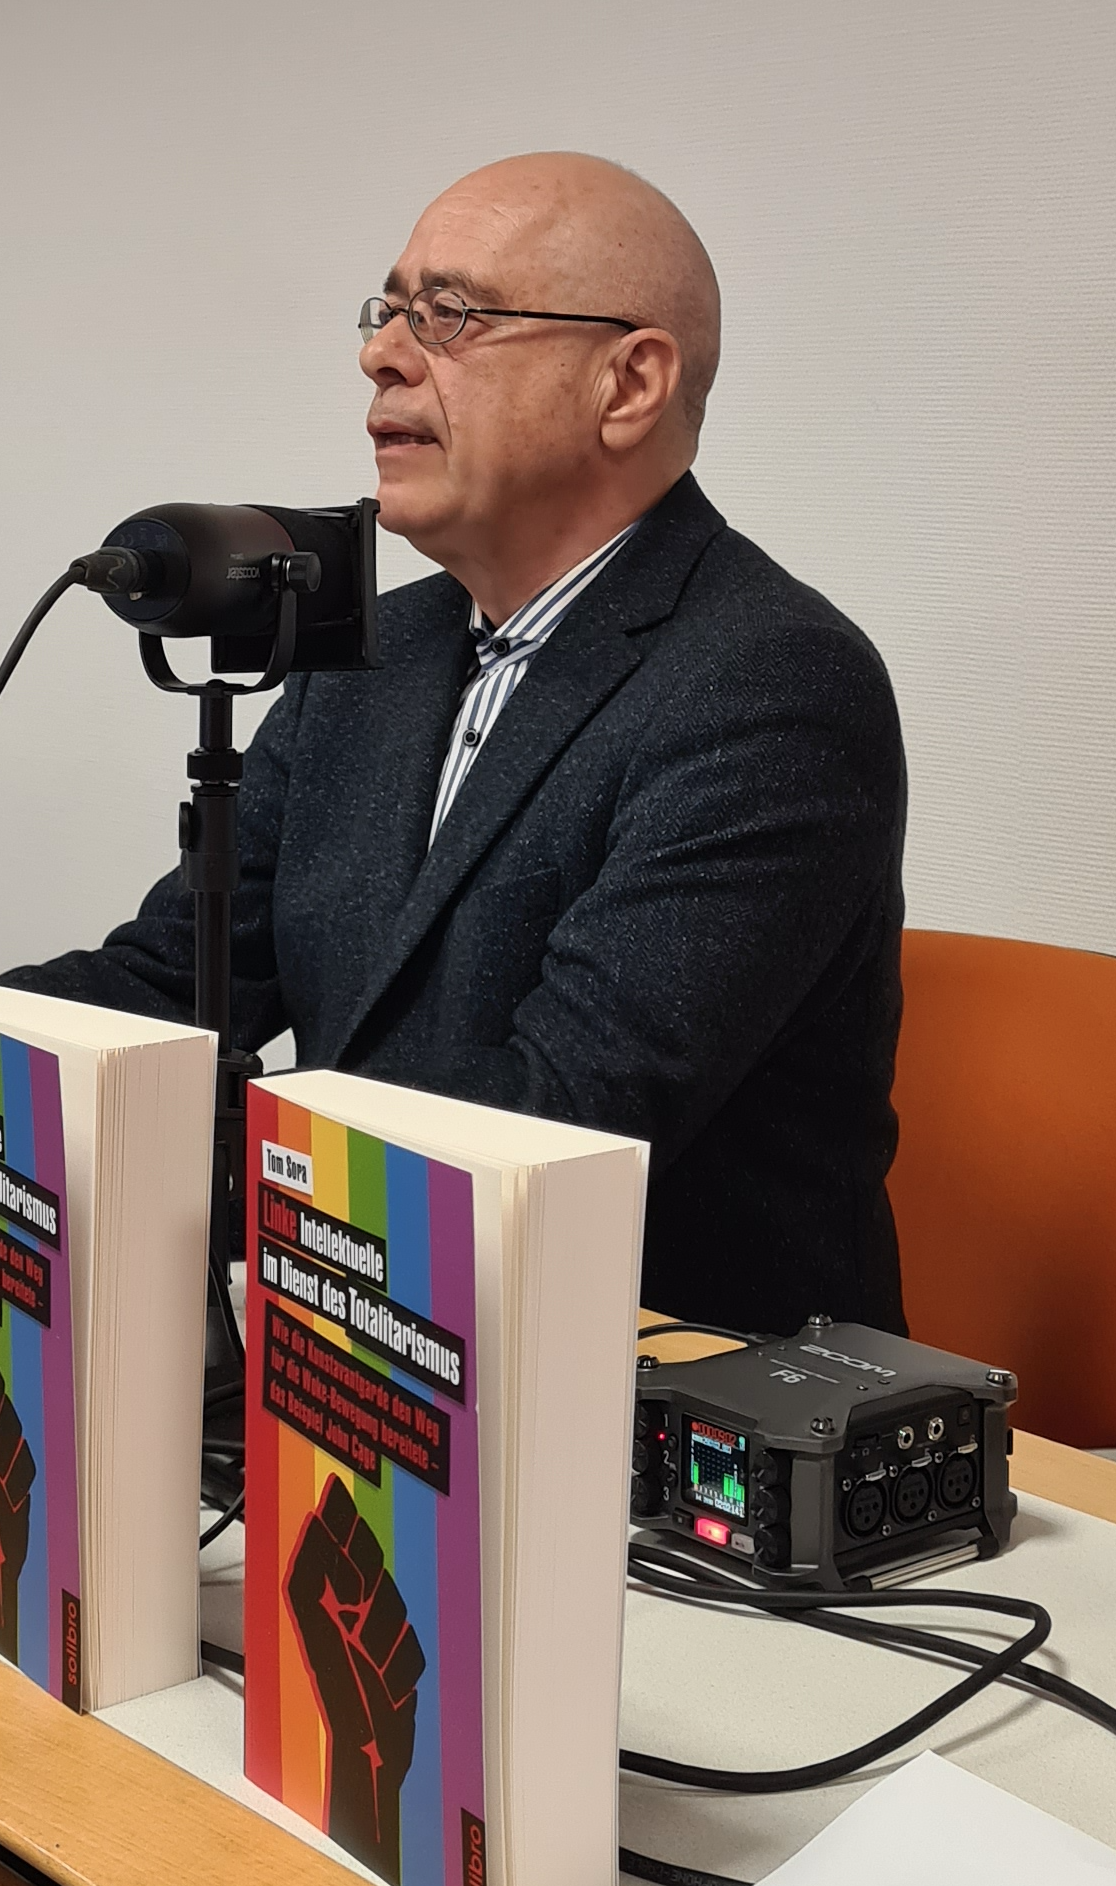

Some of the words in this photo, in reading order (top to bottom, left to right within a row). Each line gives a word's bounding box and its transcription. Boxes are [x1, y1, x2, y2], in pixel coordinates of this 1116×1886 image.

[267, 1148, 284, 1175] Tom
[286, 1155, 307, 1184] Sora
[264, 1190, 297, 1241] Linke
[300, 1211, 384, 1282] Intellektuelle
[10, 1246, 24, 1271] den
[25, 1255, 43, 1287] Weg
[263, 1247, 278, 1285] im
[281, 1255, 320, 1306] Dienst
[322, 1278, 346, 1320] des
[348, 1286, 460, 1386] Totalitarismus
[272, 1314, 289, 1346] Wie
[291, 1329, 305, 1357] die
[307, 1338, 389, 1412] Kunstavantgarde
[392, 1394, 411, 1425] den
[414, 1406, 440, 1447] Weg
[769, 1369, 807, 1384] F6
[799, 1344, 897, 1377] ZOOM
[270, 1346, 284, 1373] für
[286, 1358, 300, 1385] die
[302, 1366, 379, 1442] Woke-Bewegung
[381, 1419, 429, 1470] bereitete
[270, 1379, 285, 1408] das
[287, 1390, 323, 1436] Beispiel
[325, 1418, 349, 1452] John
[351, 1434, 376, 1471] Cage
[663, 1413, 669, 1427] 1
[663, 1450, 670, 1465] 2
[663, 1486, 670, 1501] 3
[66, 1601, 78, 1686] solibro
